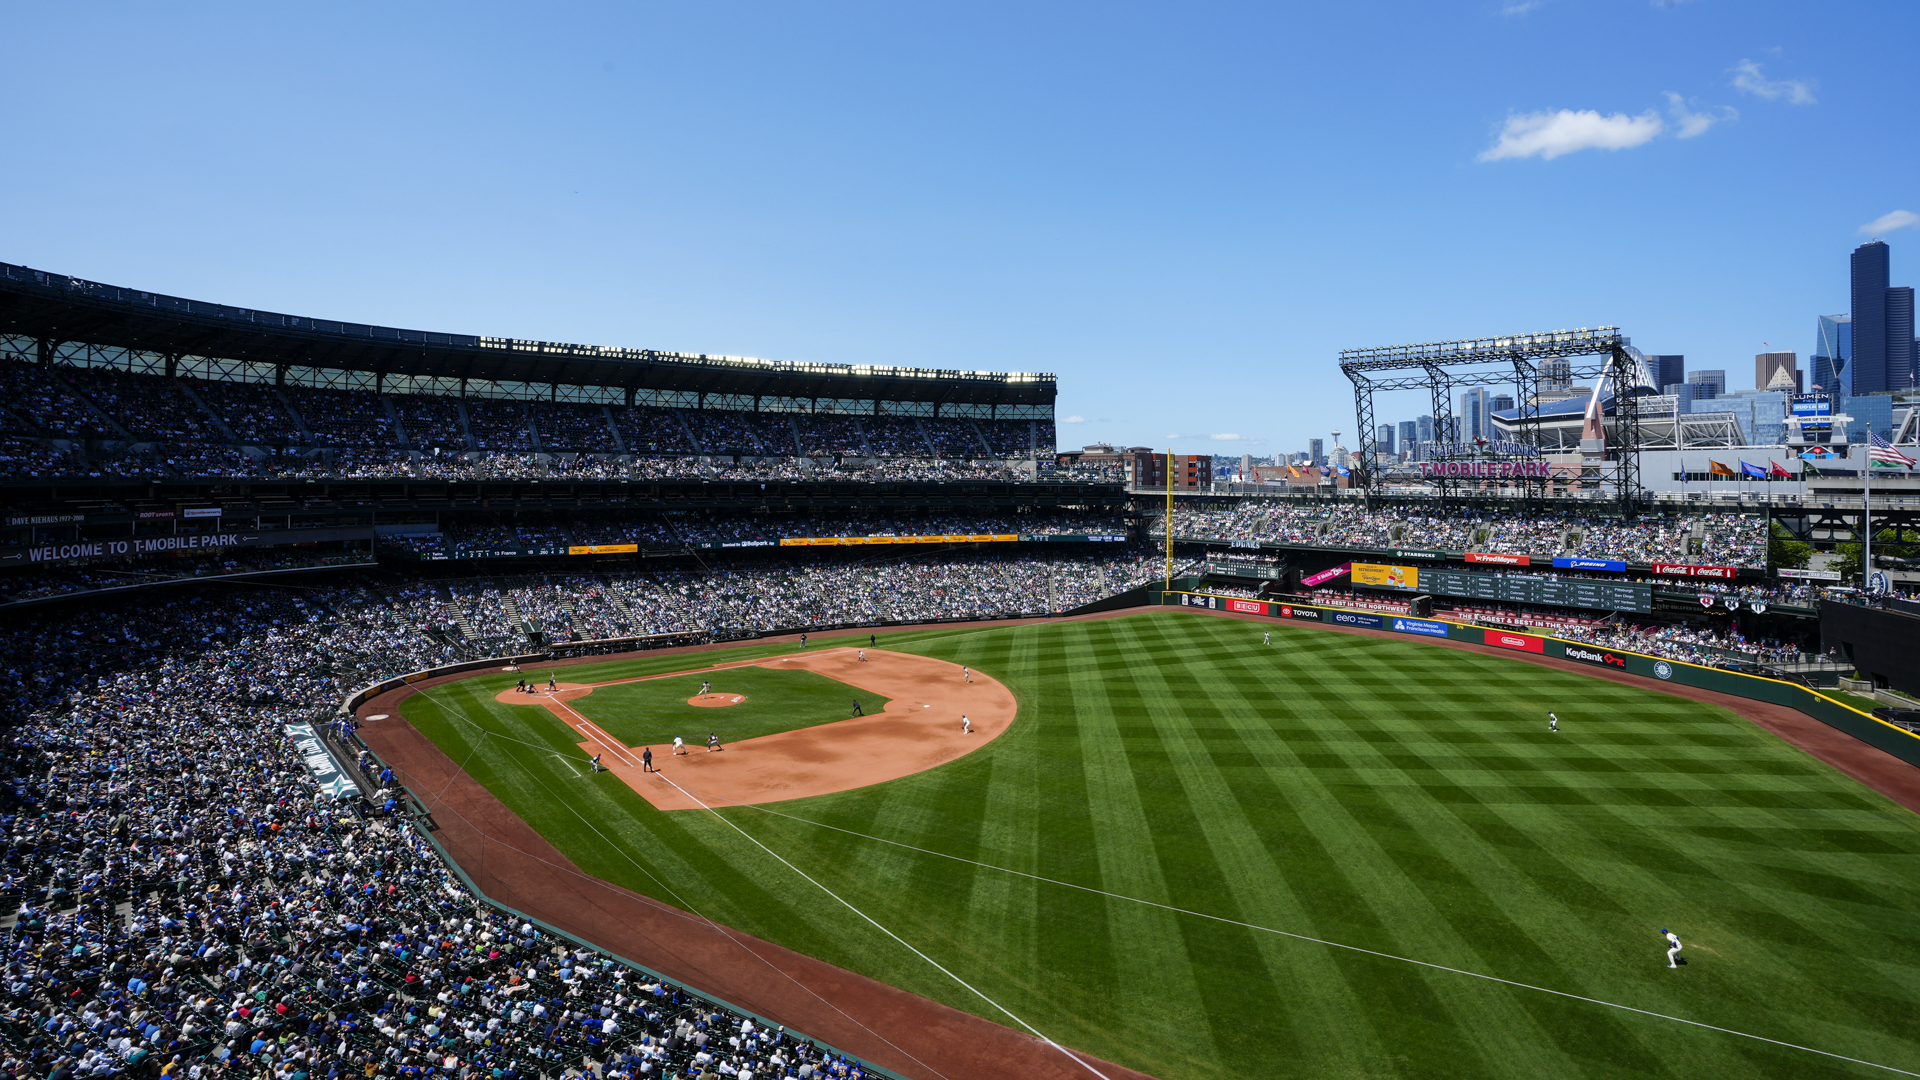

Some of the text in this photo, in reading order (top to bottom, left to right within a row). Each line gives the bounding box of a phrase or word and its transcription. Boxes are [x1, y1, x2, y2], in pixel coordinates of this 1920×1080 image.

[1429, 439, 1539, 458] SEATTLE MARINERS
[1419, 462, 1551, 476] T-MOBILE PARK
[12, 516, 29, 525] DAVE
[31, 516, 58, 524] NIEHAUS
[29, 534, 238, 562] WELCOME TO T-MOBILE PARK
[1662, 565, 1688, 575] Coca-Cola
[1697, 567, 1724, 577] Coca-Cola
[1236, 602, 1258, 611] BECU
[1368, 603, 1408, 612] NORTHWEST
[1755, 604, 1761, 612] 11
[1293, 609, 1318, 618] TOYOTA
[1336, 614, 1356, 623] eero
[1474, 614, 1505, 623] GGEST
[1503, 638, 1523, 646] Nintendo
[1565, 647, 1603, 662] KeyBank
